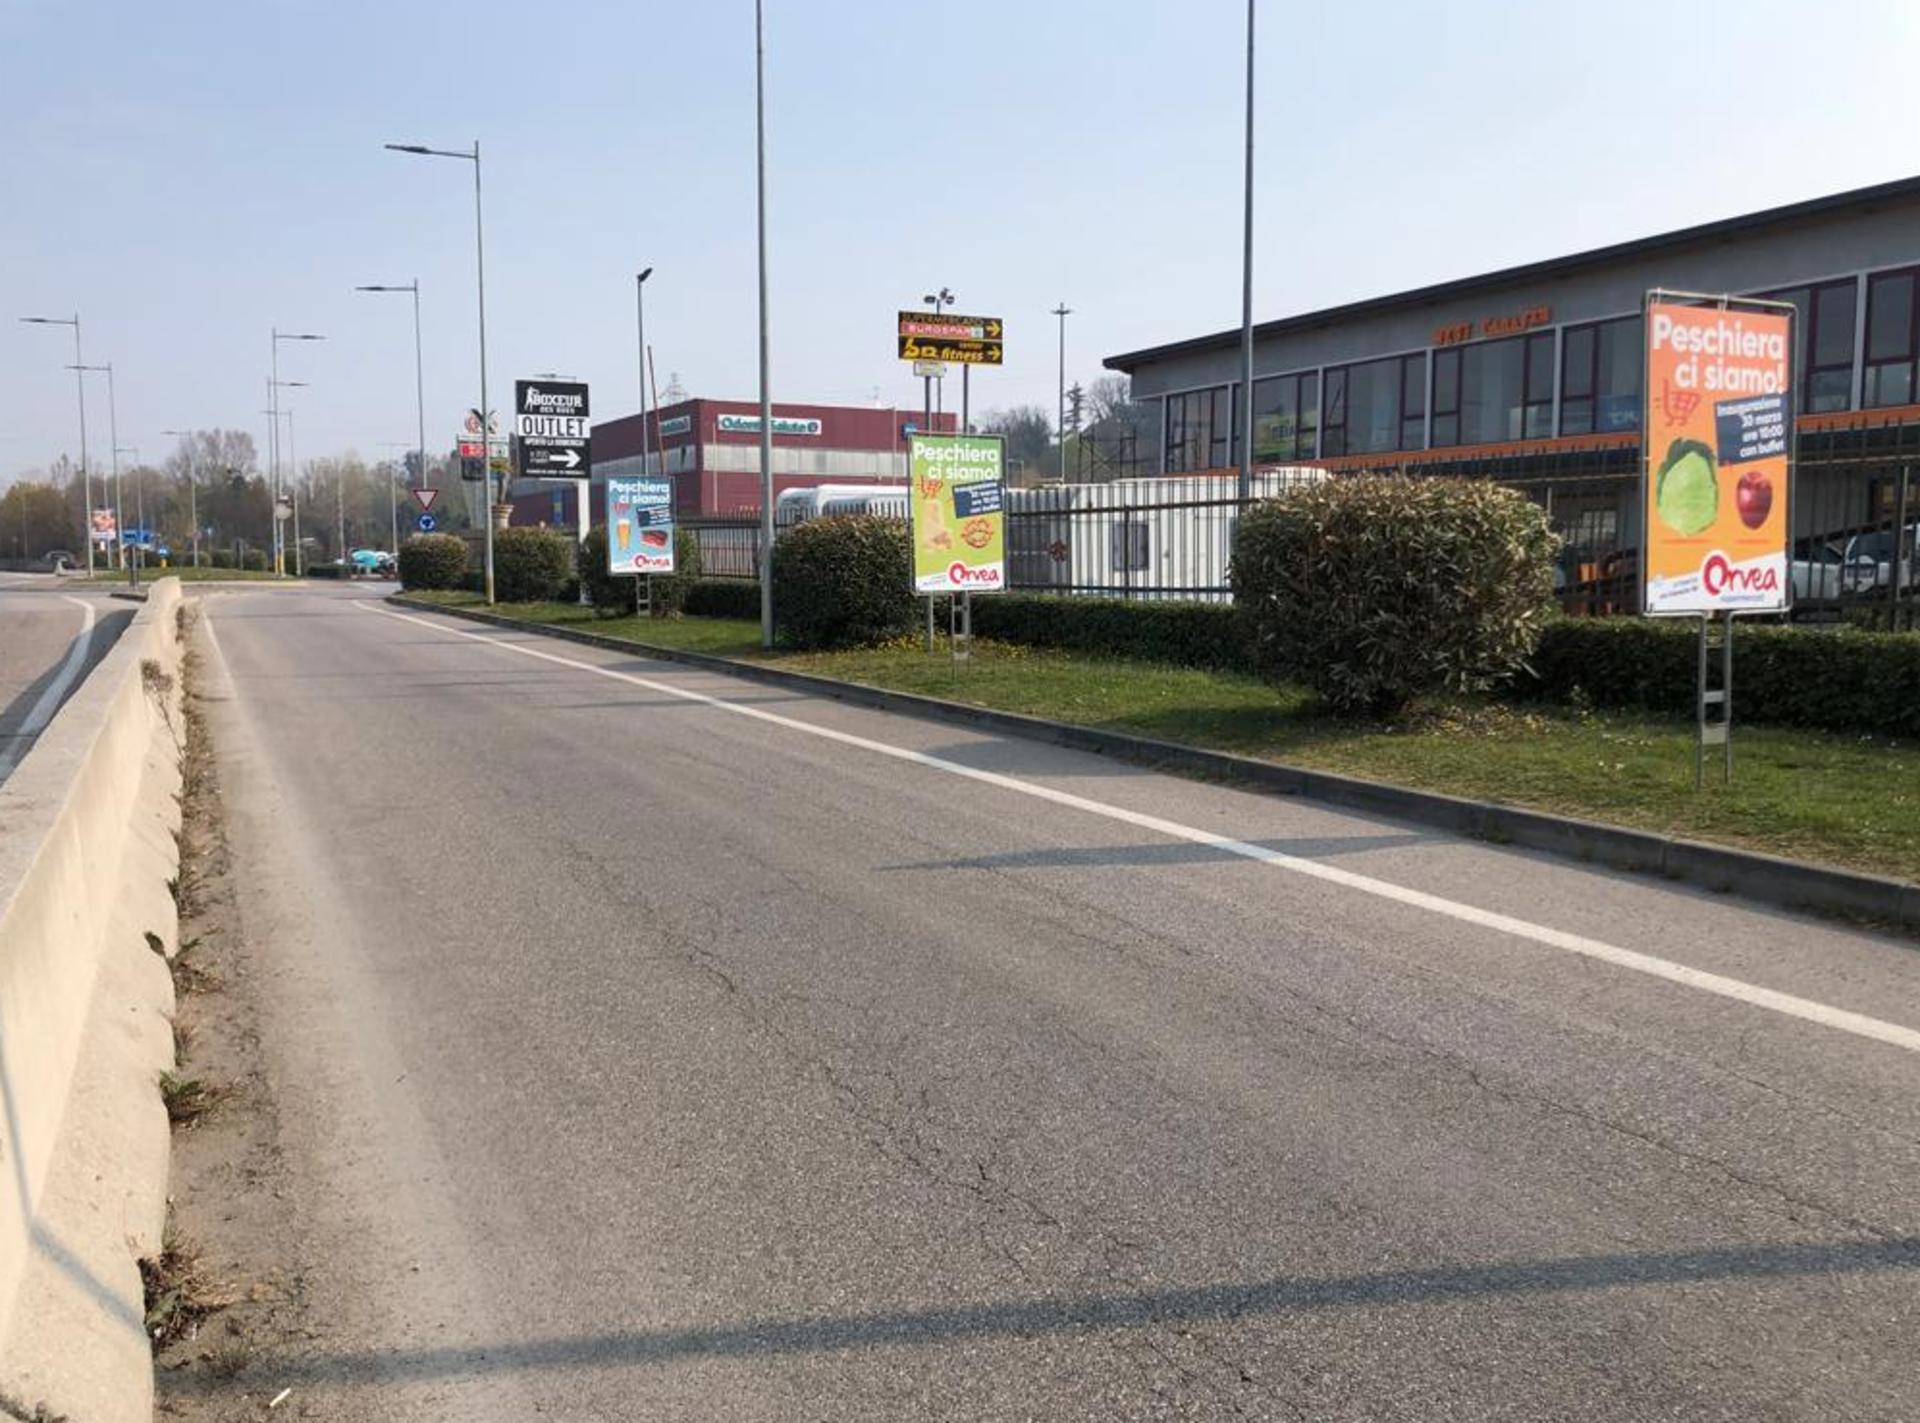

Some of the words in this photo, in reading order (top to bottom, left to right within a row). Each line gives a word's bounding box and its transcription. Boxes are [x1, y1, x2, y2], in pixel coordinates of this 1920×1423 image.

[1652, 314, 1784, 360] Peschiera
[941, 347, 984, 361] fitness
[1674, 354, 1697, 388] ci
[1704, 358, 1786, 395] siamo!
[522, 416, 585, 437] OUTLET
[913, 441, 998, 463] Peschiera
[928, 462, 942, 480] ci
[946, 462, 1001, 481] siamo!
[608, 479, 670, 494] Peschiera
[949, 562, 1000, 585] Orvea
[1703, 554, 1779, 596] Orvea
